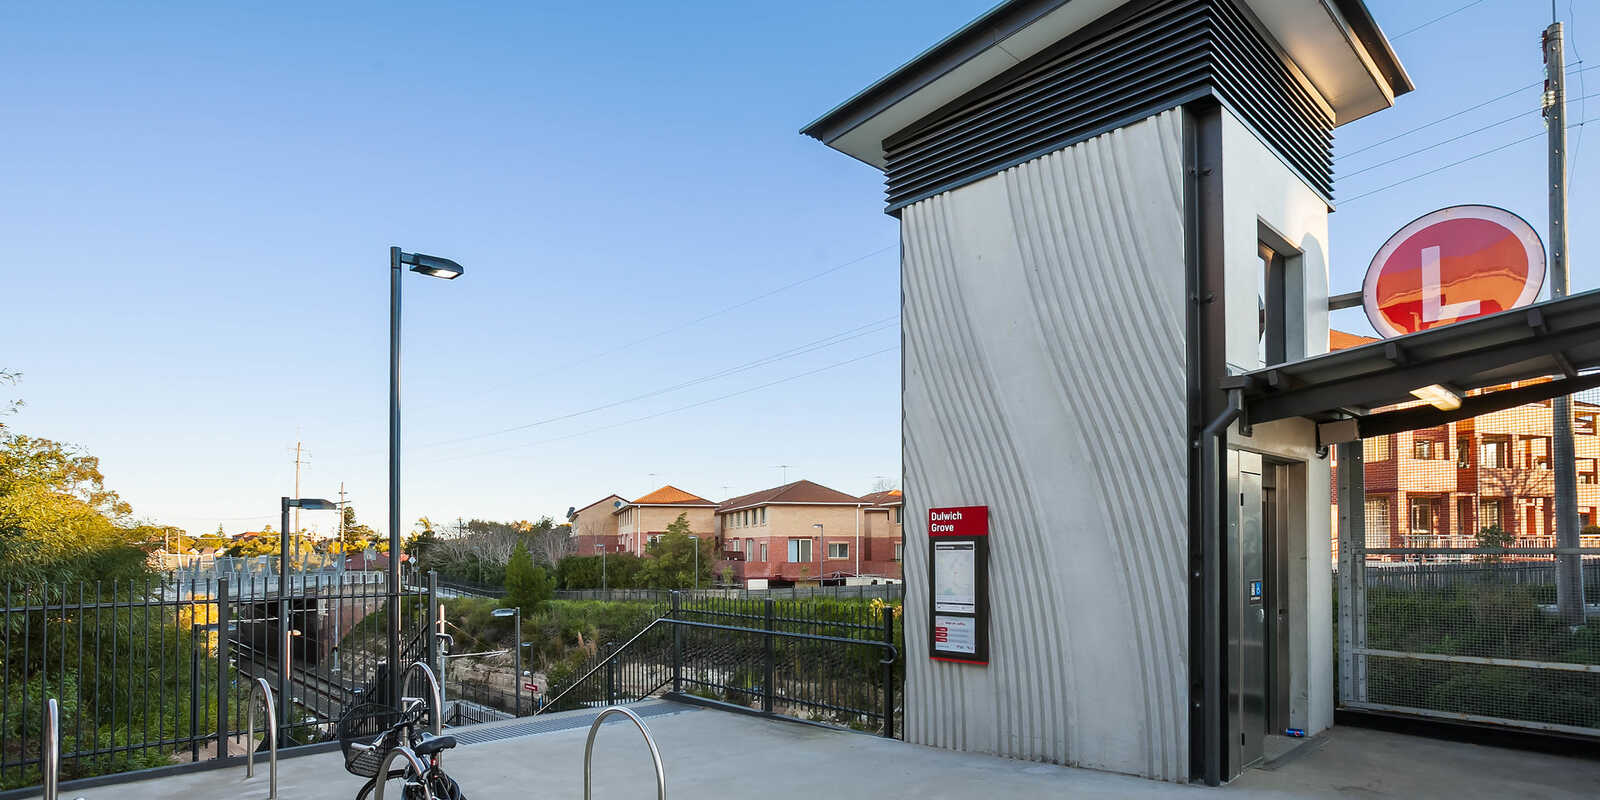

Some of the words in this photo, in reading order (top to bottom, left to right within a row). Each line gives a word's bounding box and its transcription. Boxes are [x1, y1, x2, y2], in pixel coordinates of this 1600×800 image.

[1421, 245, 1481, 323] L
[931, 511, 962, 521] Dulwich
[931, 523, 954, 532] Grove
